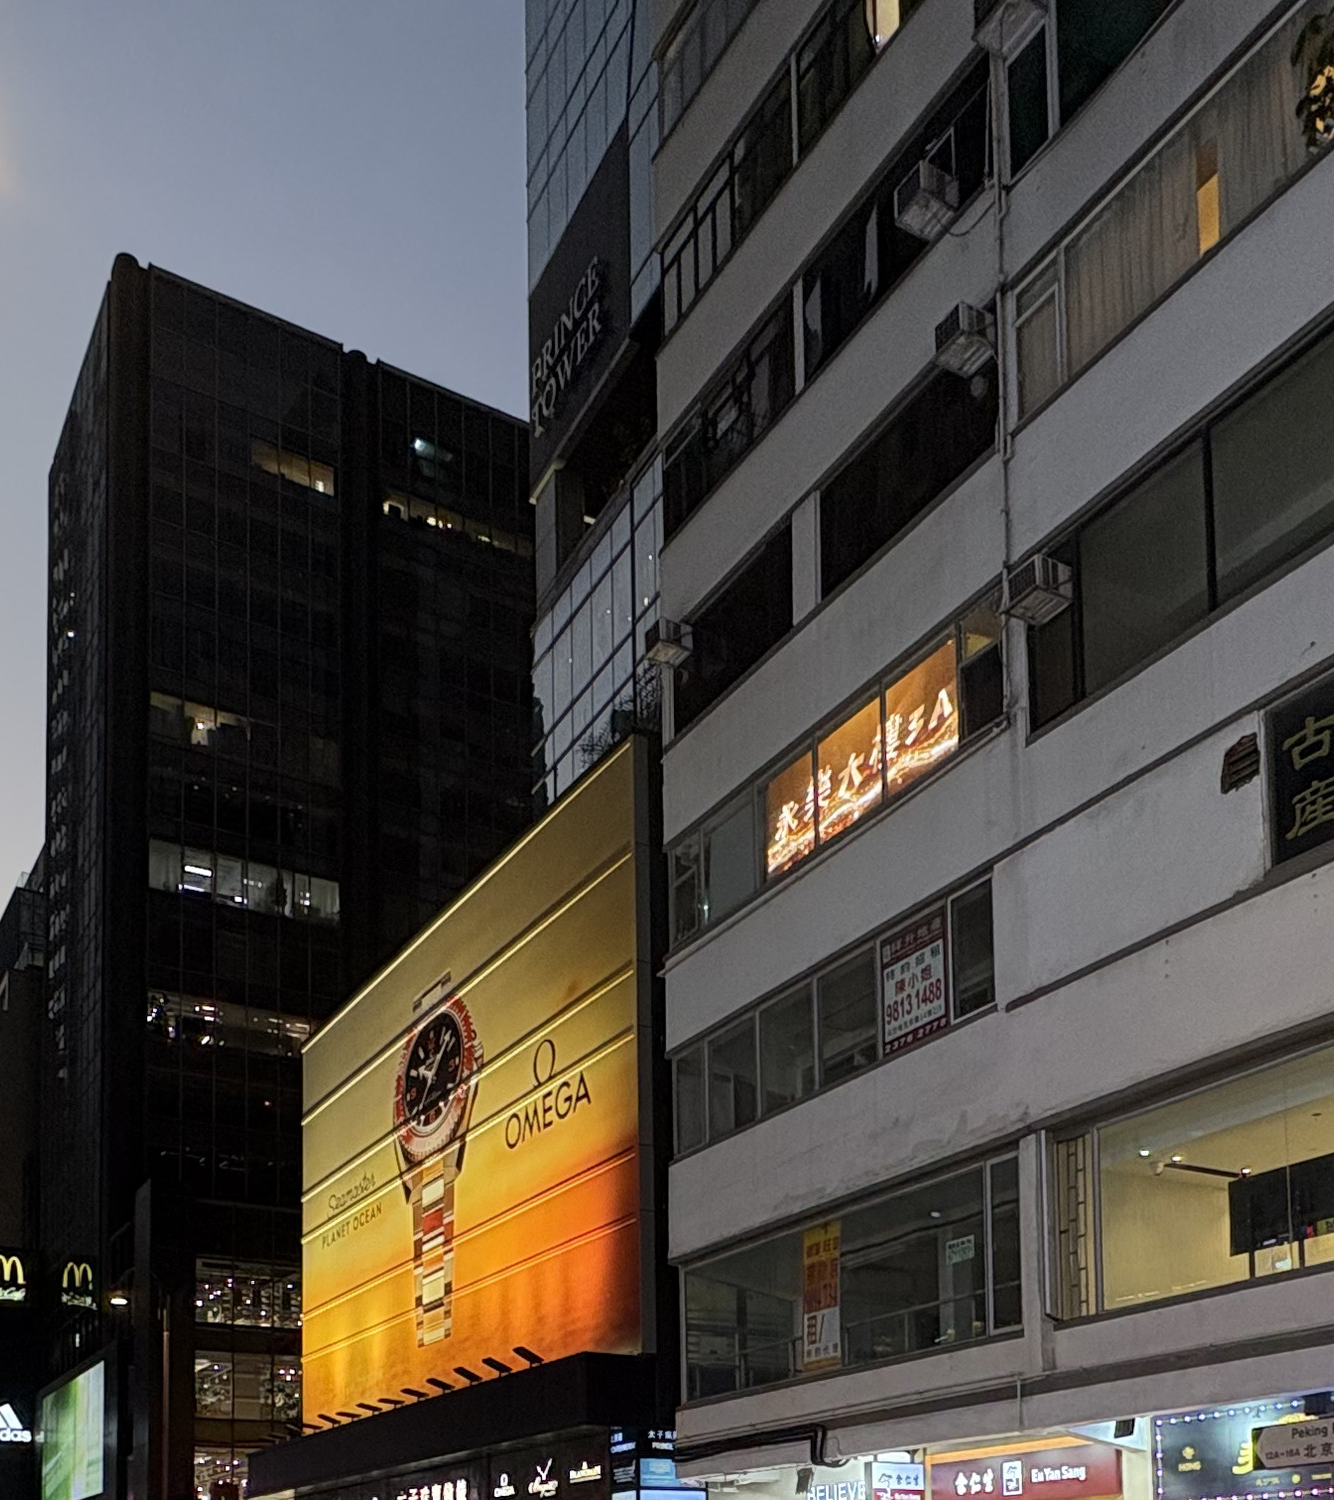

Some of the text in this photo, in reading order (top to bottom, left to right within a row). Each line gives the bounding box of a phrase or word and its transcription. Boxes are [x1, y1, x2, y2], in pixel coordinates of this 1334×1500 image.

[531, 256, 600, 398] PRINCE
[531, 302, 602, 439] TOWER
[886, 993, 913, 1026] 9813
[915, 978, 942, 1010] 1488
[505, 1070, 592, 1151] OMEGA
[321, 1201, 383, 1250] PLANET OCEAN
[1291, 1424, 1328, 1440] Peking
[1031, 1465, 1087, 1483] Eu Yan Sang
